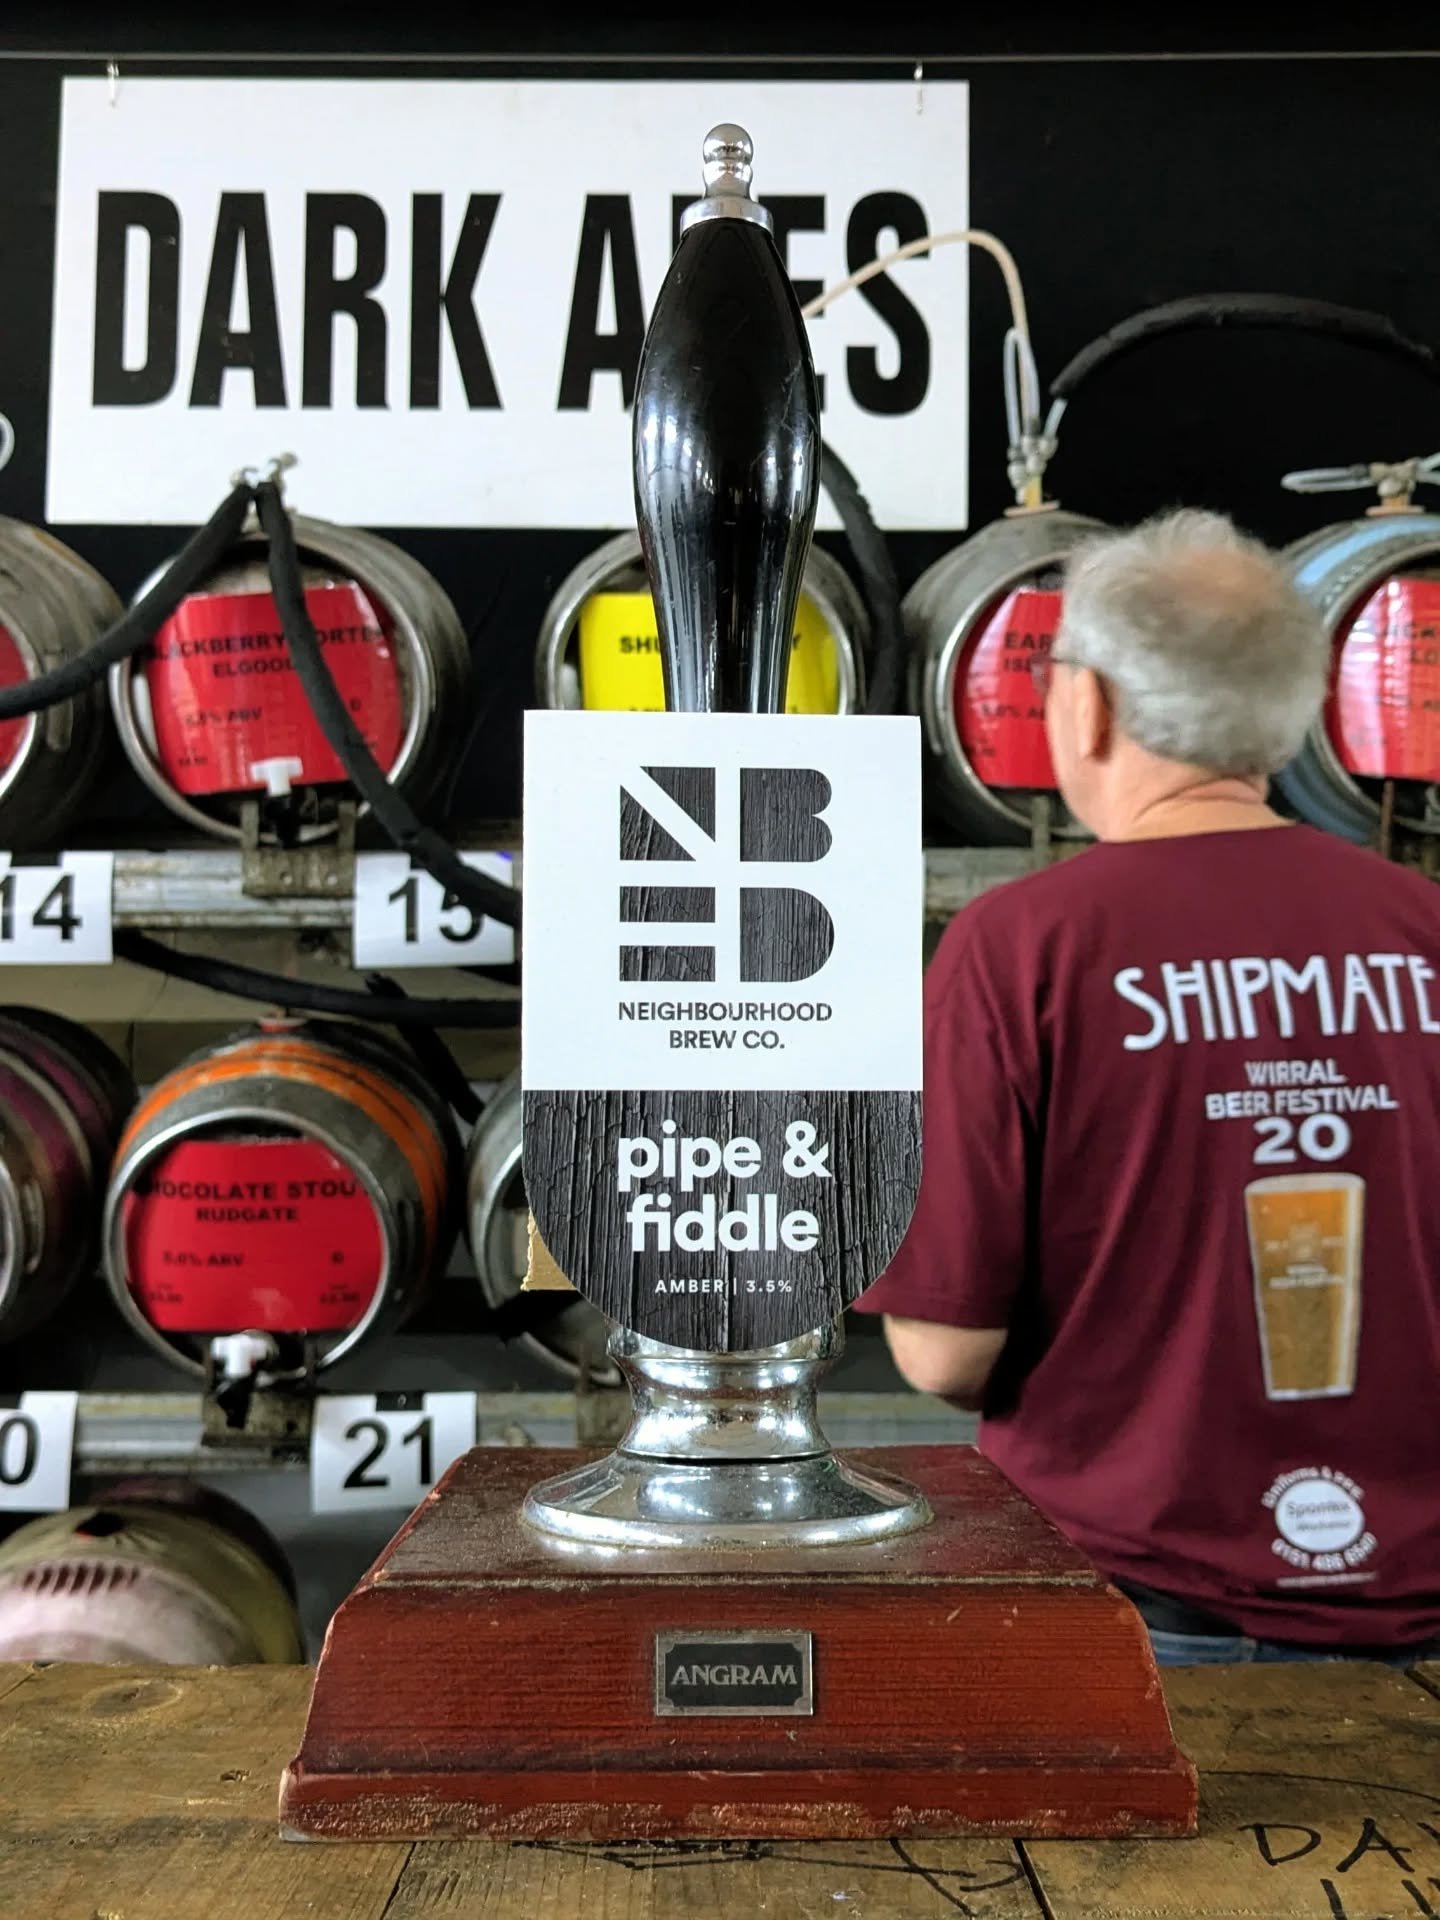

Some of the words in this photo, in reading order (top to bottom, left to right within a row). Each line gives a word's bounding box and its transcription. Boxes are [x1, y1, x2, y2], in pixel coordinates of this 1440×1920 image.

[92, 189, 504, 412] DARK
[314, 625, 382, 645] ORTE
[1004, 632, 1053, 650] EAR
[0, 874, 81, 942] 14
[388, 872, 484, 943] 15
[618, 1001, 833, 1022] NEIGHBOURHOOD
[669, 1030, 737, 1050] BREW
[742, 1030, 786, 1050] CO.
[1244, 1058, 1347, 1087] WIRRAL
[1205, 1091, 1271, 1121] BEER
[1274, 1084, 1399, 1116] FESTIVAL
[1252, 1112, 1352, 1165] 20
[617, 1119, 762, 1192] pipe
[782, 1120, 833, 1178] &
[148, 1180, 277, 1201] OCOLATE
[287, 1179, 369, 1199] STOU
[196, 1206, 299, 1223] RUDGATE
[626, 1192, 820, 1252] fiddle
[655, 1279, 725, 1294] AMBER
[746, 1279, 793, 1294] 3.5%
[343, 1417, 435, 1490] 21
[670, 1664, 798, 1687] ANGRAM
